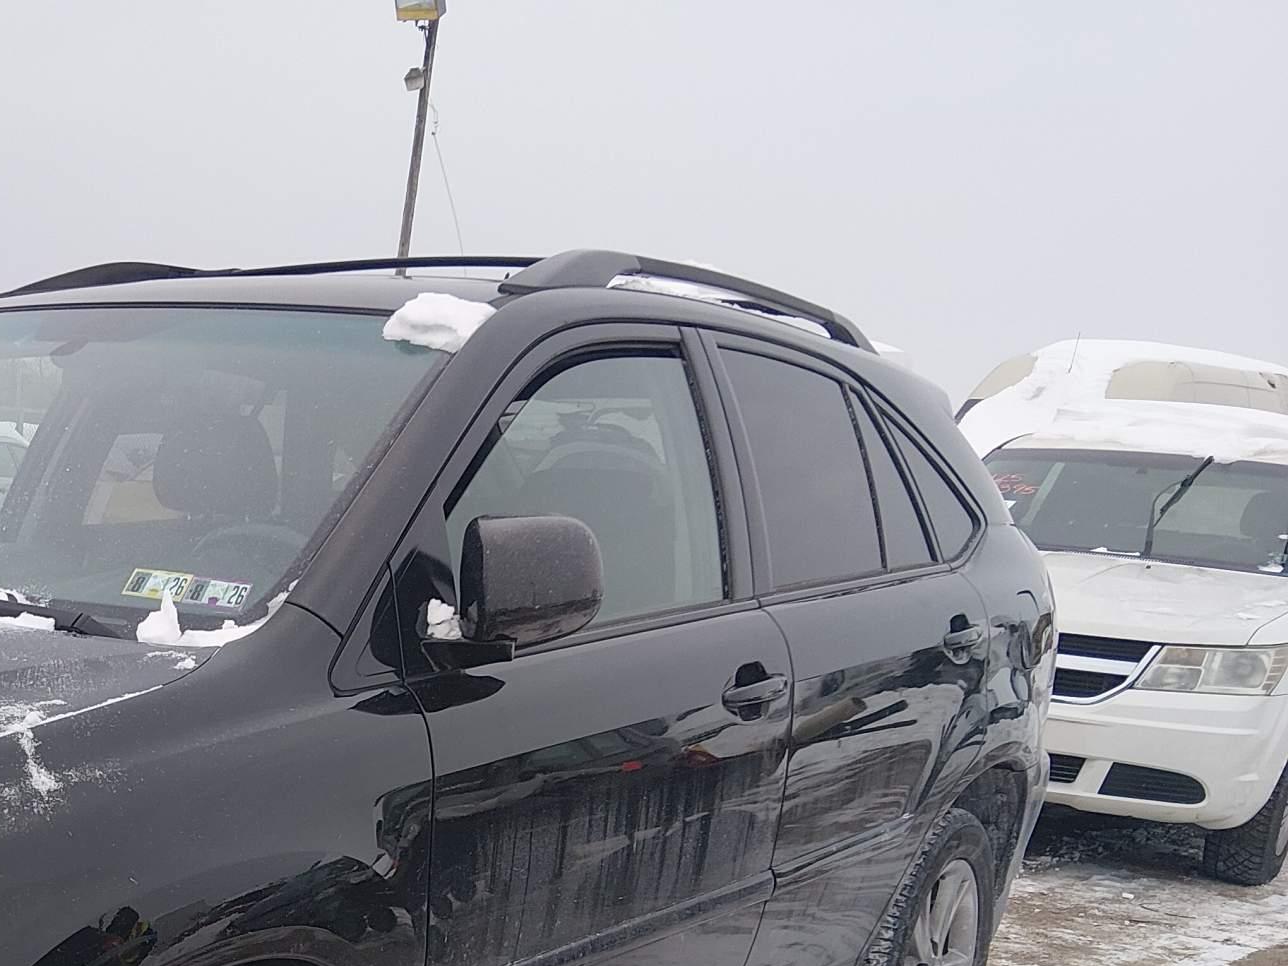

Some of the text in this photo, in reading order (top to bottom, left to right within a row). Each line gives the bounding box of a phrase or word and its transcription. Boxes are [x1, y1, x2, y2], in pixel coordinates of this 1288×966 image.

[131, 576, 188, 596] 8 26
[189, 583, 248, 606] 8 26
